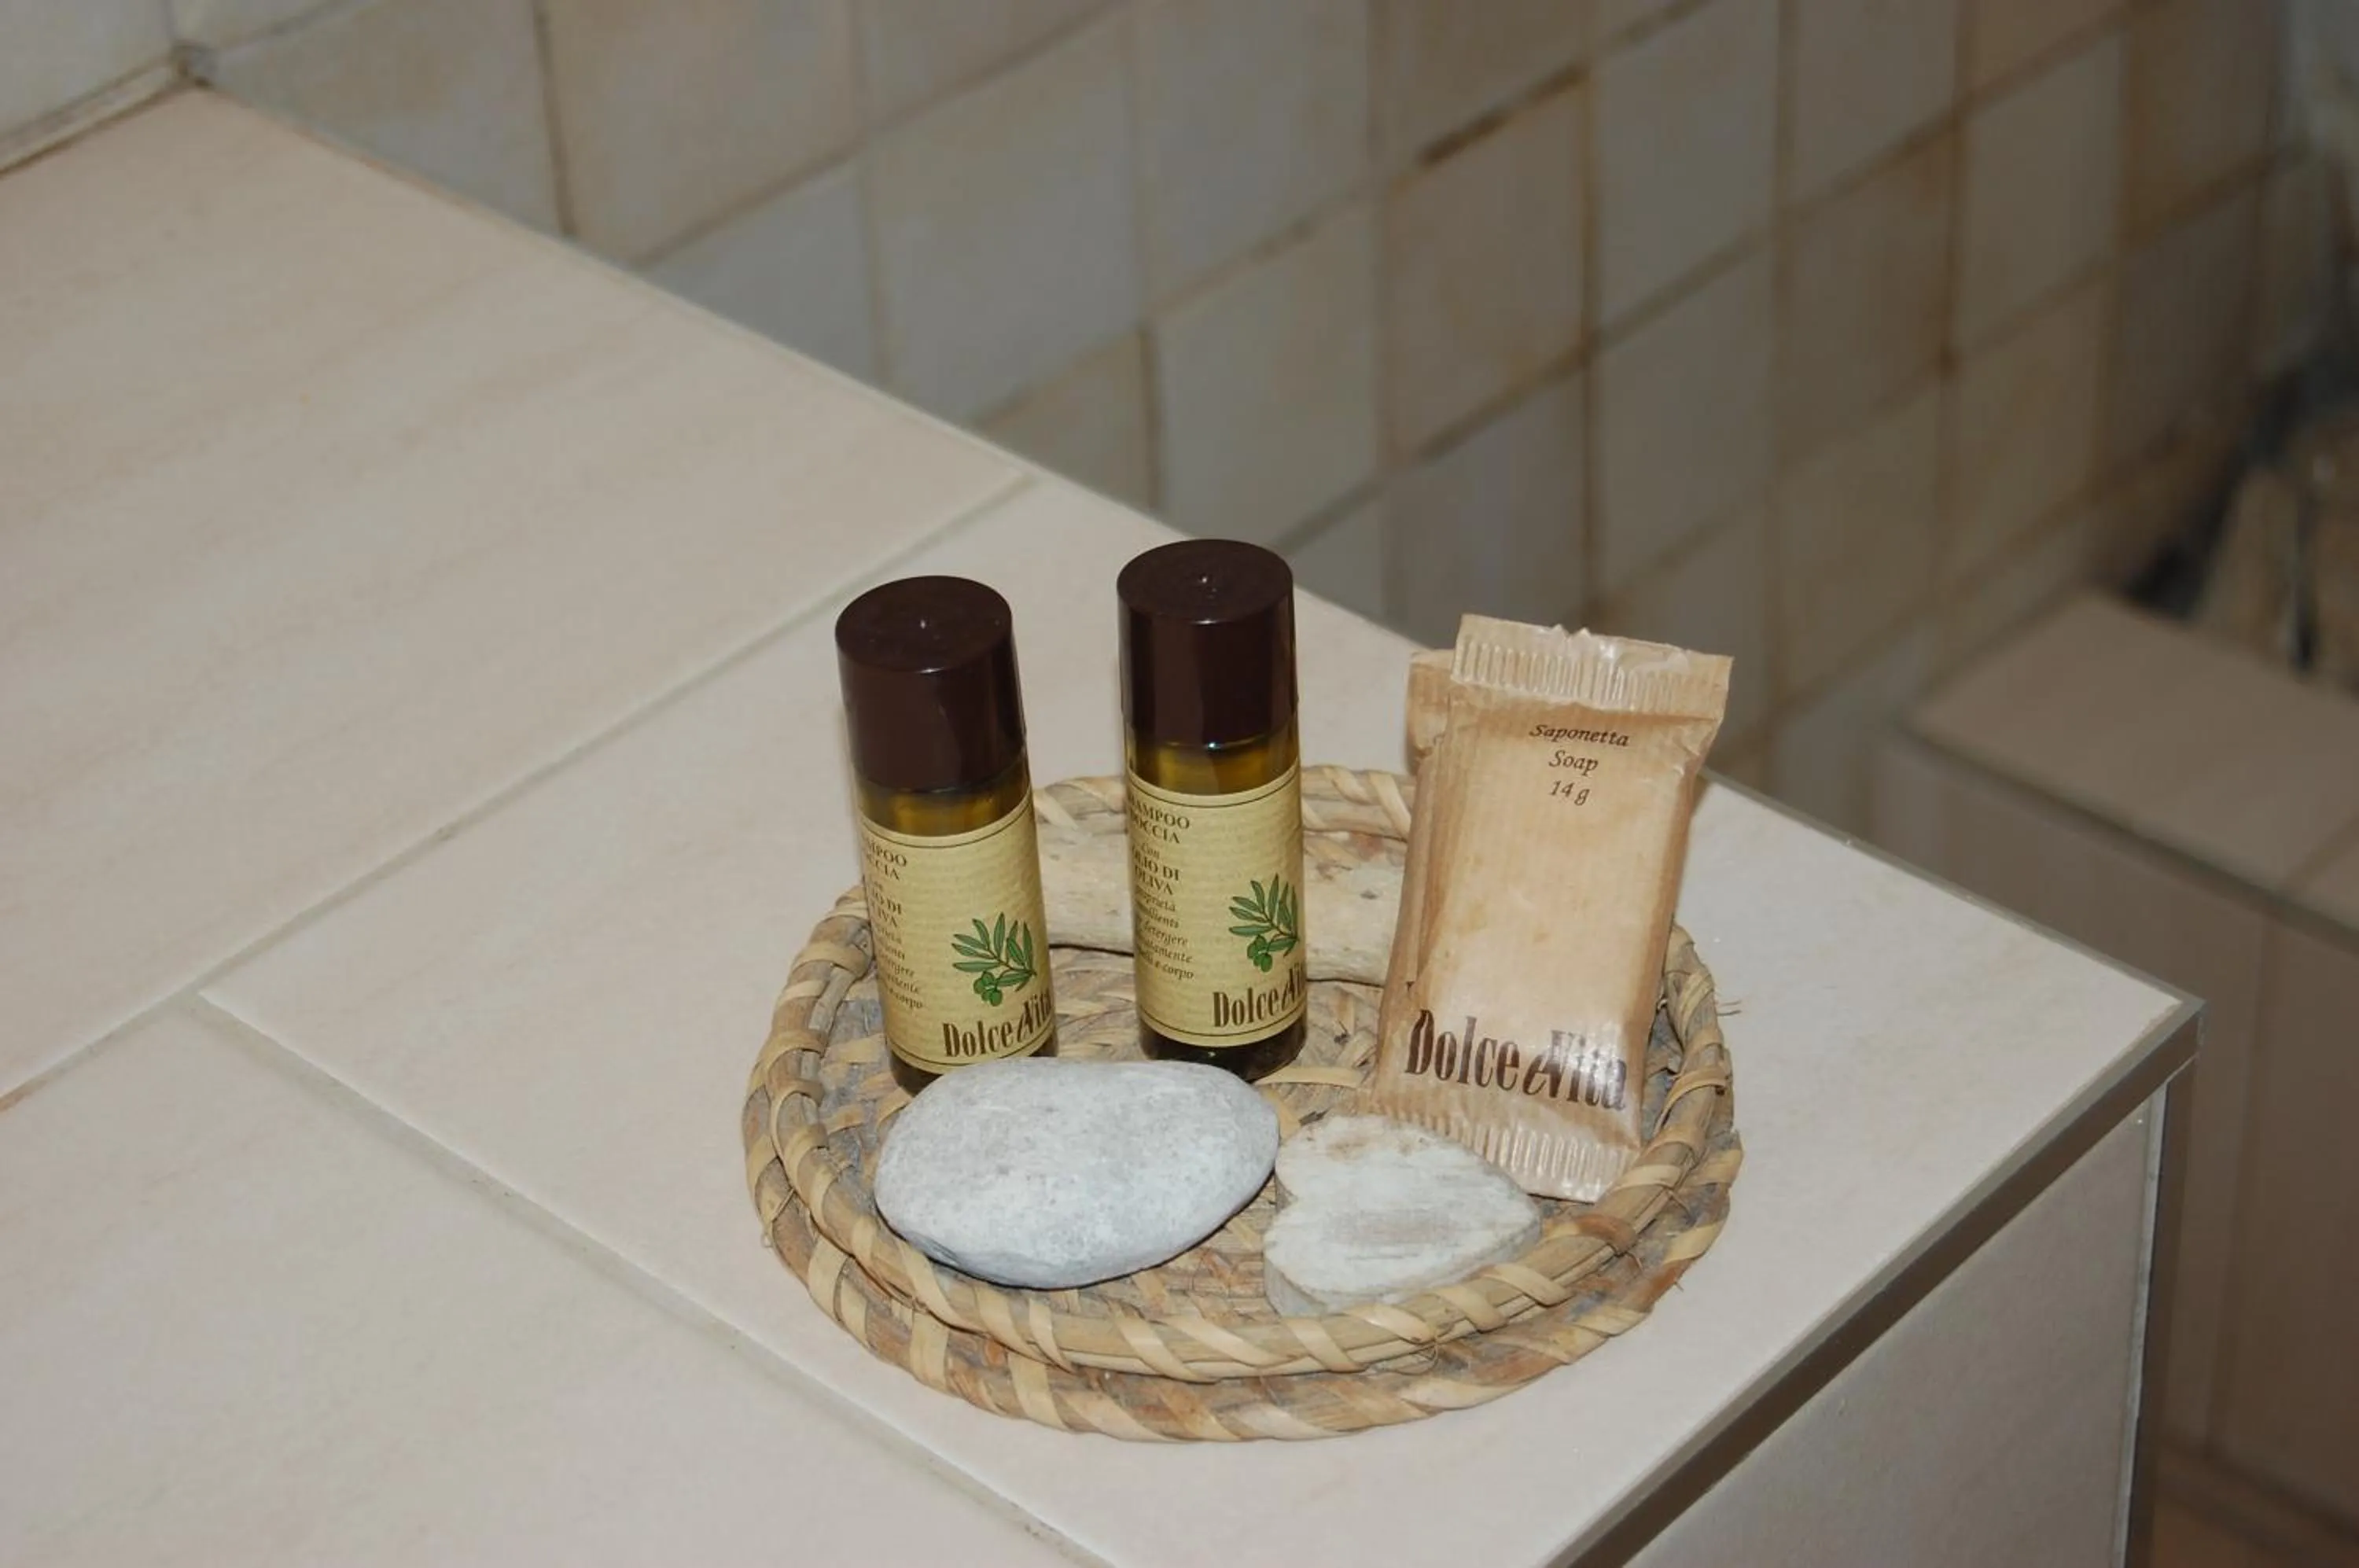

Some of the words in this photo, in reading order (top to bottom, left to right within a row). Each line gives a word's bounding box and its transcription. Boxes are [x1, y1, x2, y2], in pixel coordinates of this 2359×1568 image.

[1529, 723, 1629, 747] Saponetta
[1548, 749, 1599, 777] Soap
[1550, 780, 1574, 797] 14
[1574, 788, 1591, 807] g
[1163, 865, 1179, 881] DI
